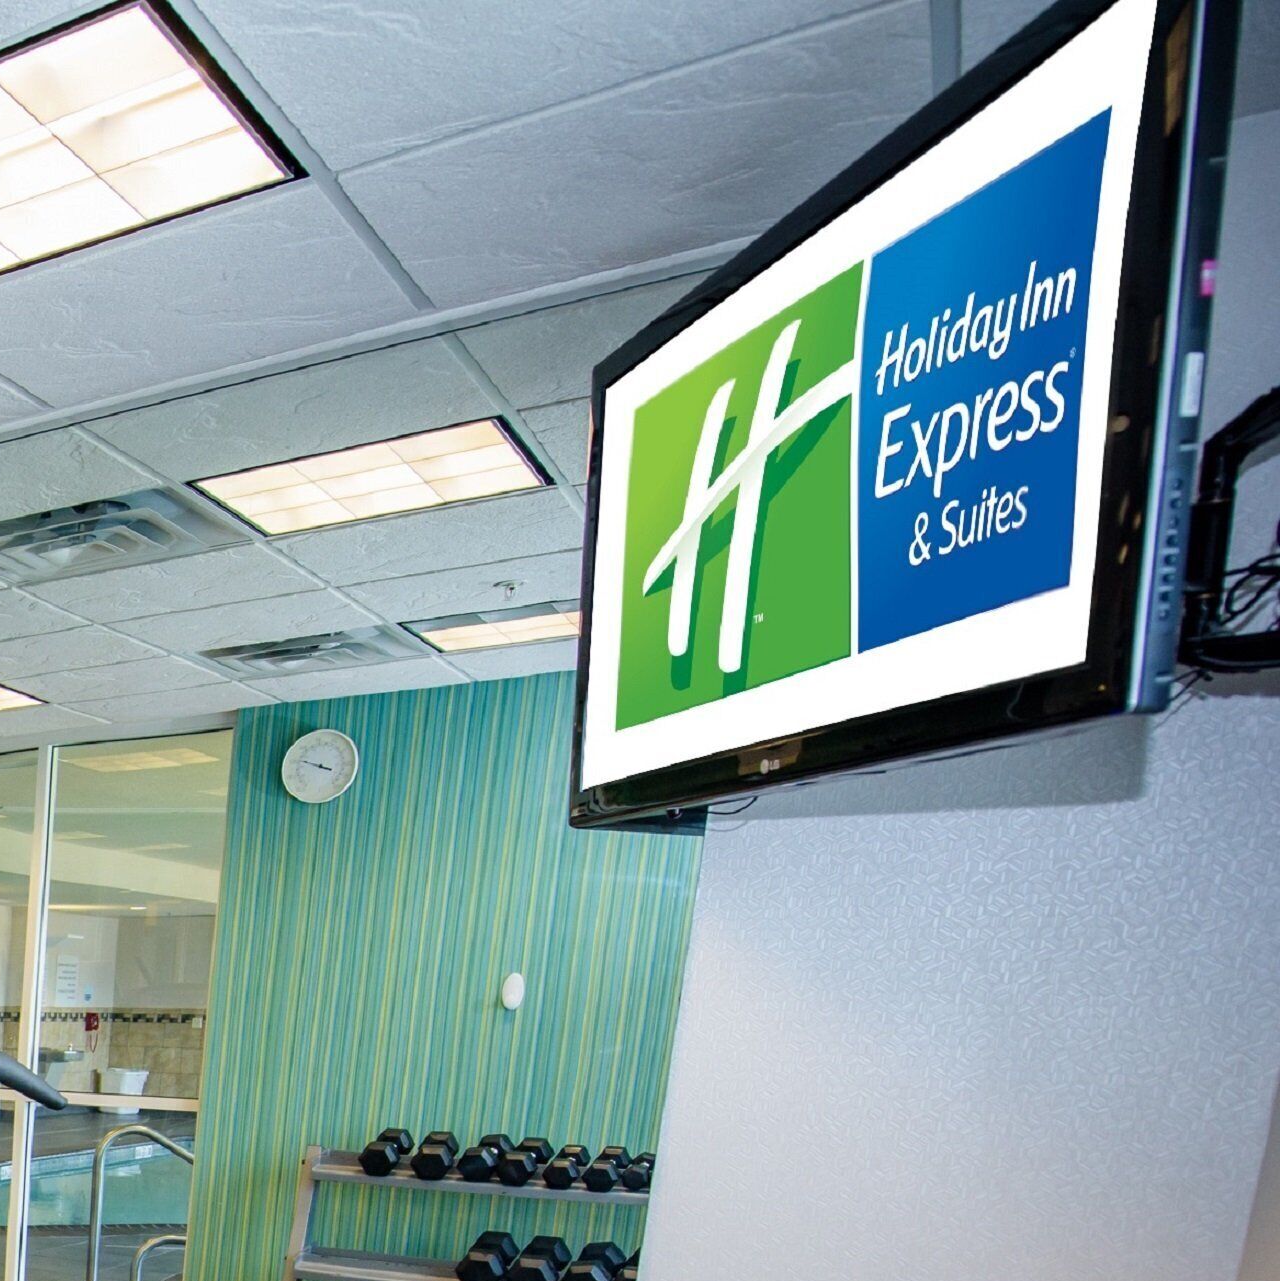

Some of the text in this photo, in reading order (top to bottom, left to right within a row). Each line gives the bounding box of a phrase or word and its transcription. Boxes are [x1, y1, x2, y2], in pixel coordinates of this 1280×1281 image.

[875, 259, 1076, 396] Holiday Inn
[874, 360, 1069, 499] Express
[908, 485, 1029, 566] & Suites
